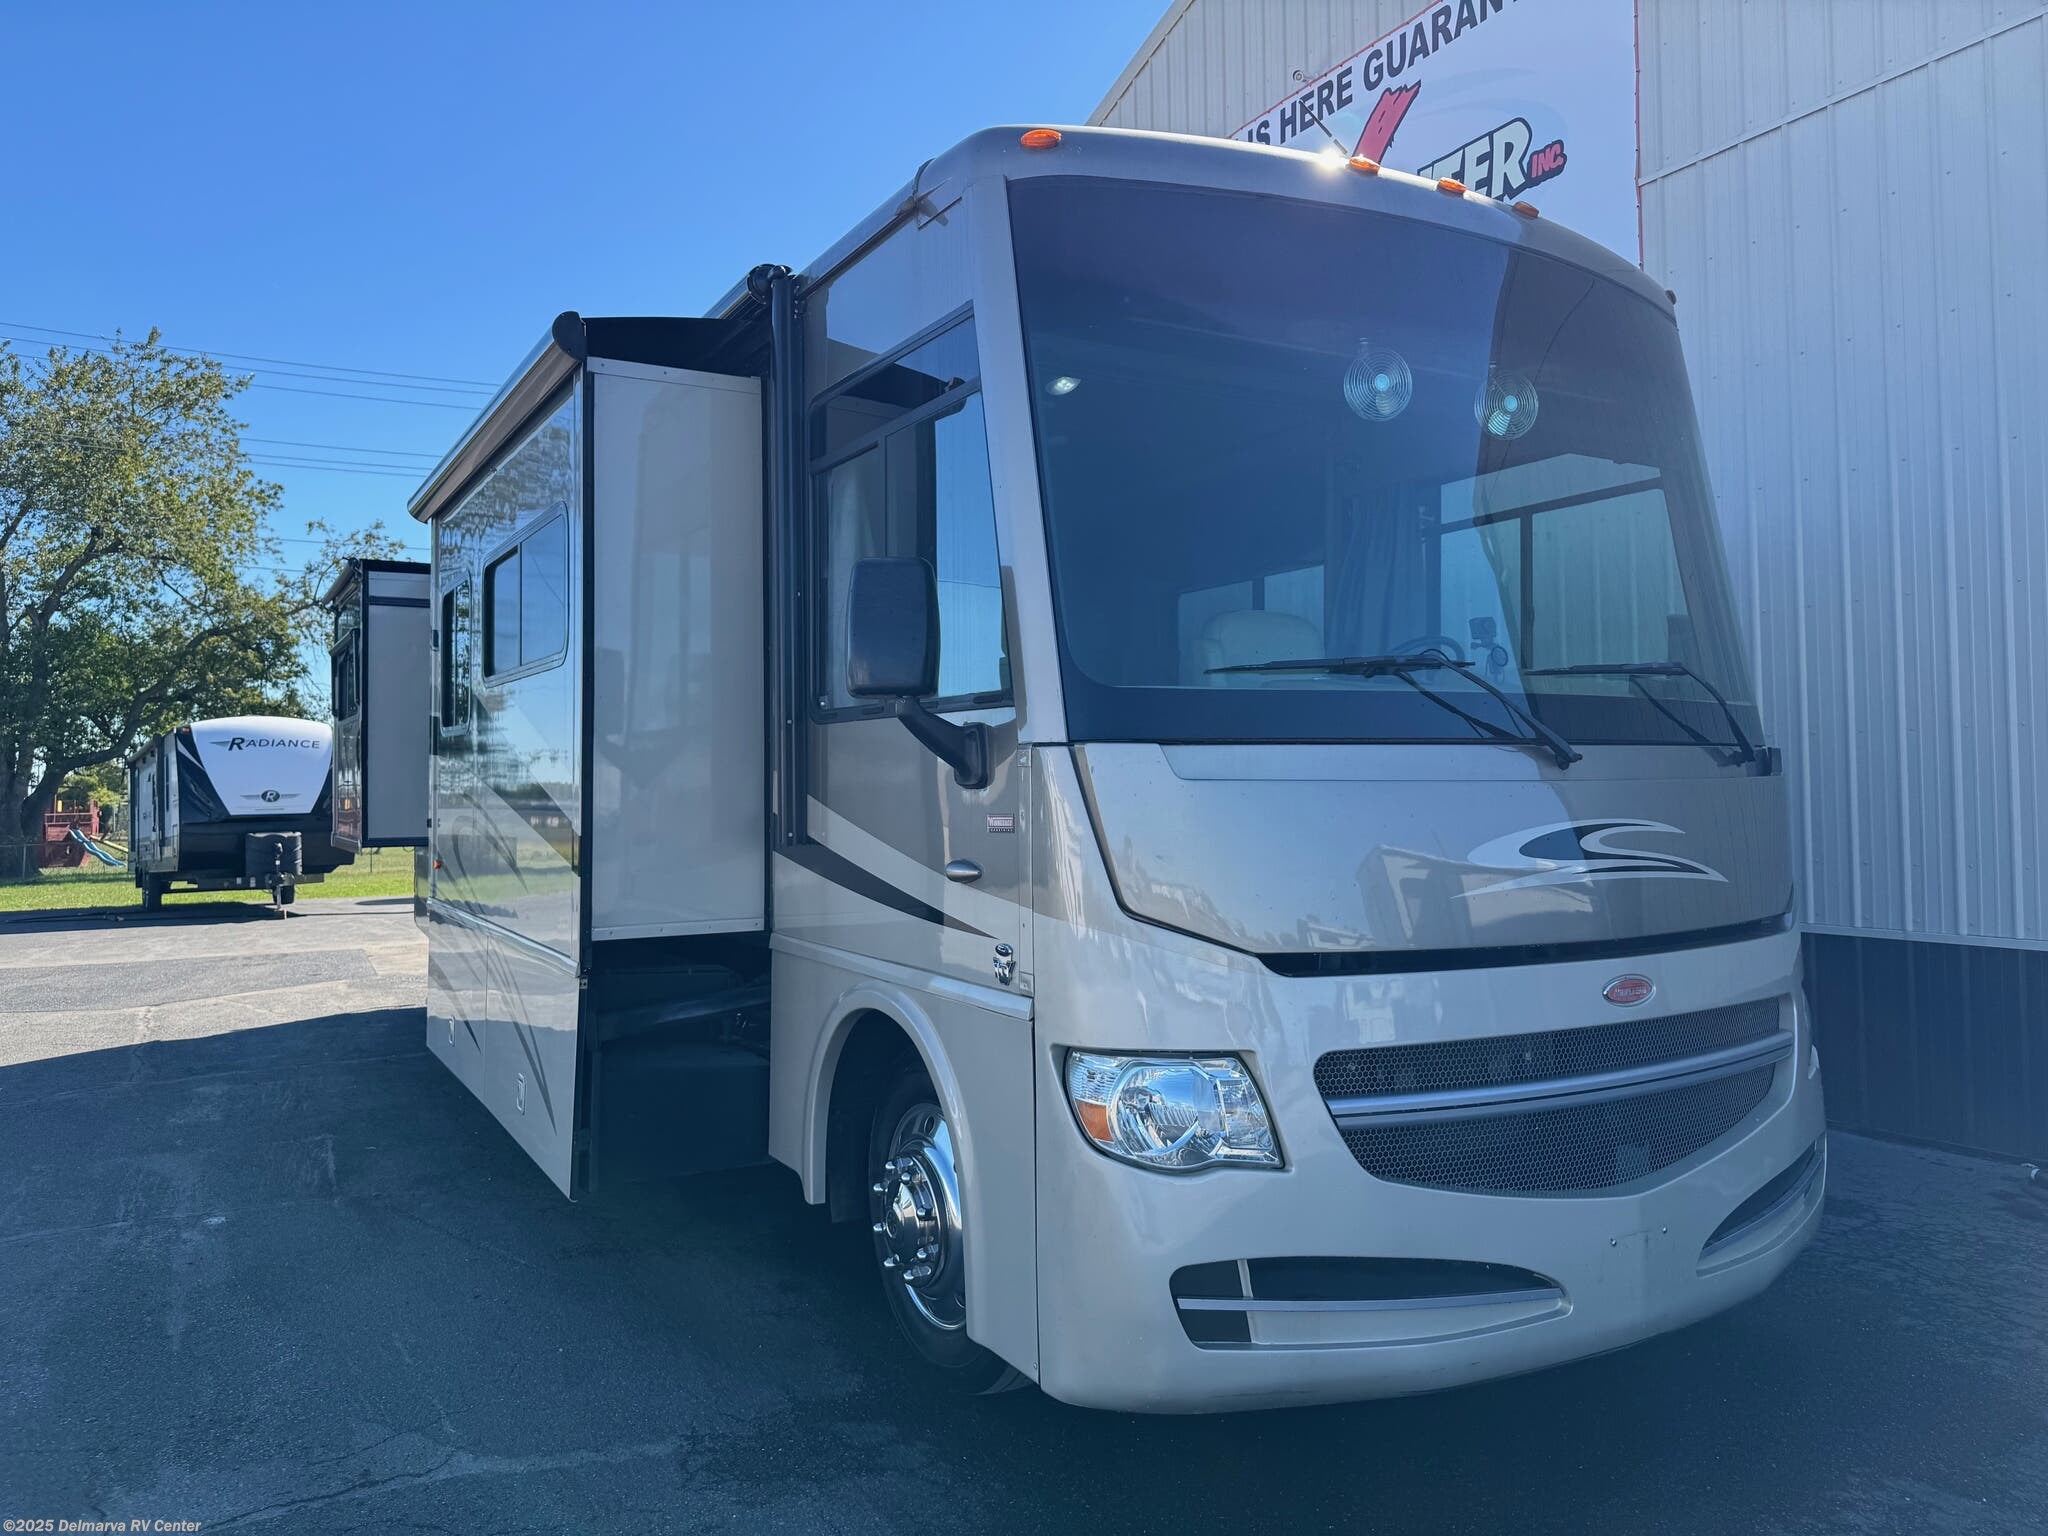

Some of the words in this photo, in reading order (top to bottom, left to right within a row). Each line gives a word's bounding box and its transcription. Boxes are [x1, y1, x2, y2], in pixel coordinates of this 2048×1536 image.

[1280, 65, 1353, 144] HERE
[1363, 0, 1517, 91] GUARA
[1419, 119, 1530, 200] ER
[228, 737, 321, 751] RADIANCE
